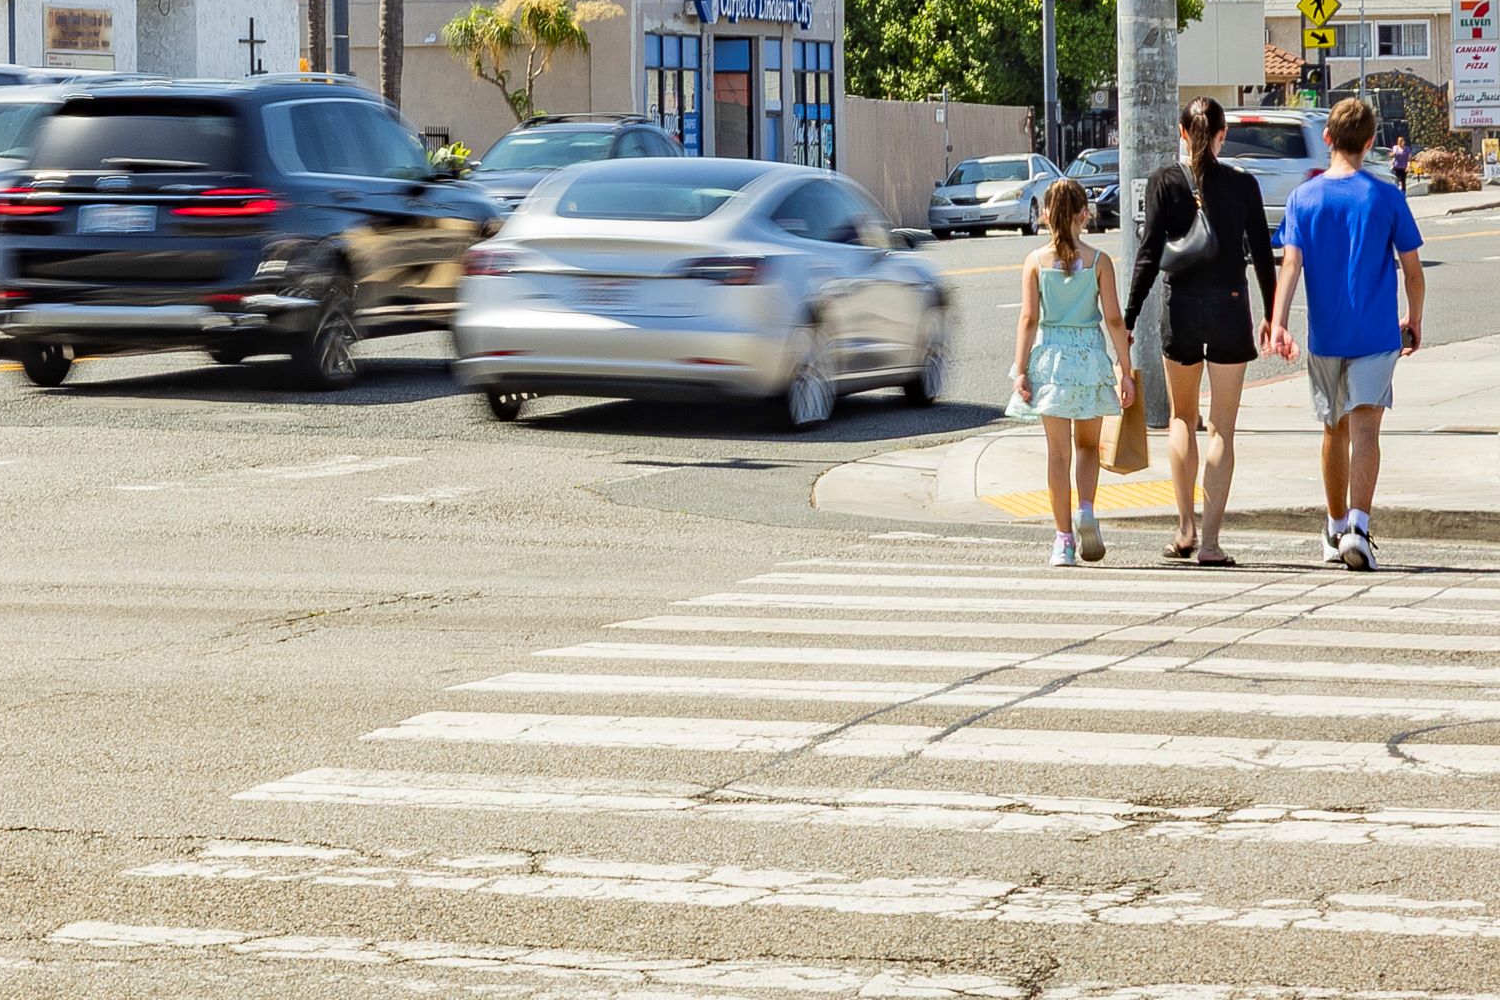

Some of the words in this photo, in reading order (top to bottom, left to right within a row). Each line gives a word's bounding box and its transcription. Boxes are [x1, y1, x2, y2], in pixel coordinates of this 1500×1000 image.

[1455, 45, 1497, 54] CANADIAN
[1465, 62, 1489, 70] PIZZA
[1470, 109, 1484, 117] DRY
[1460, 117, 1494, 125] CLEANERS
